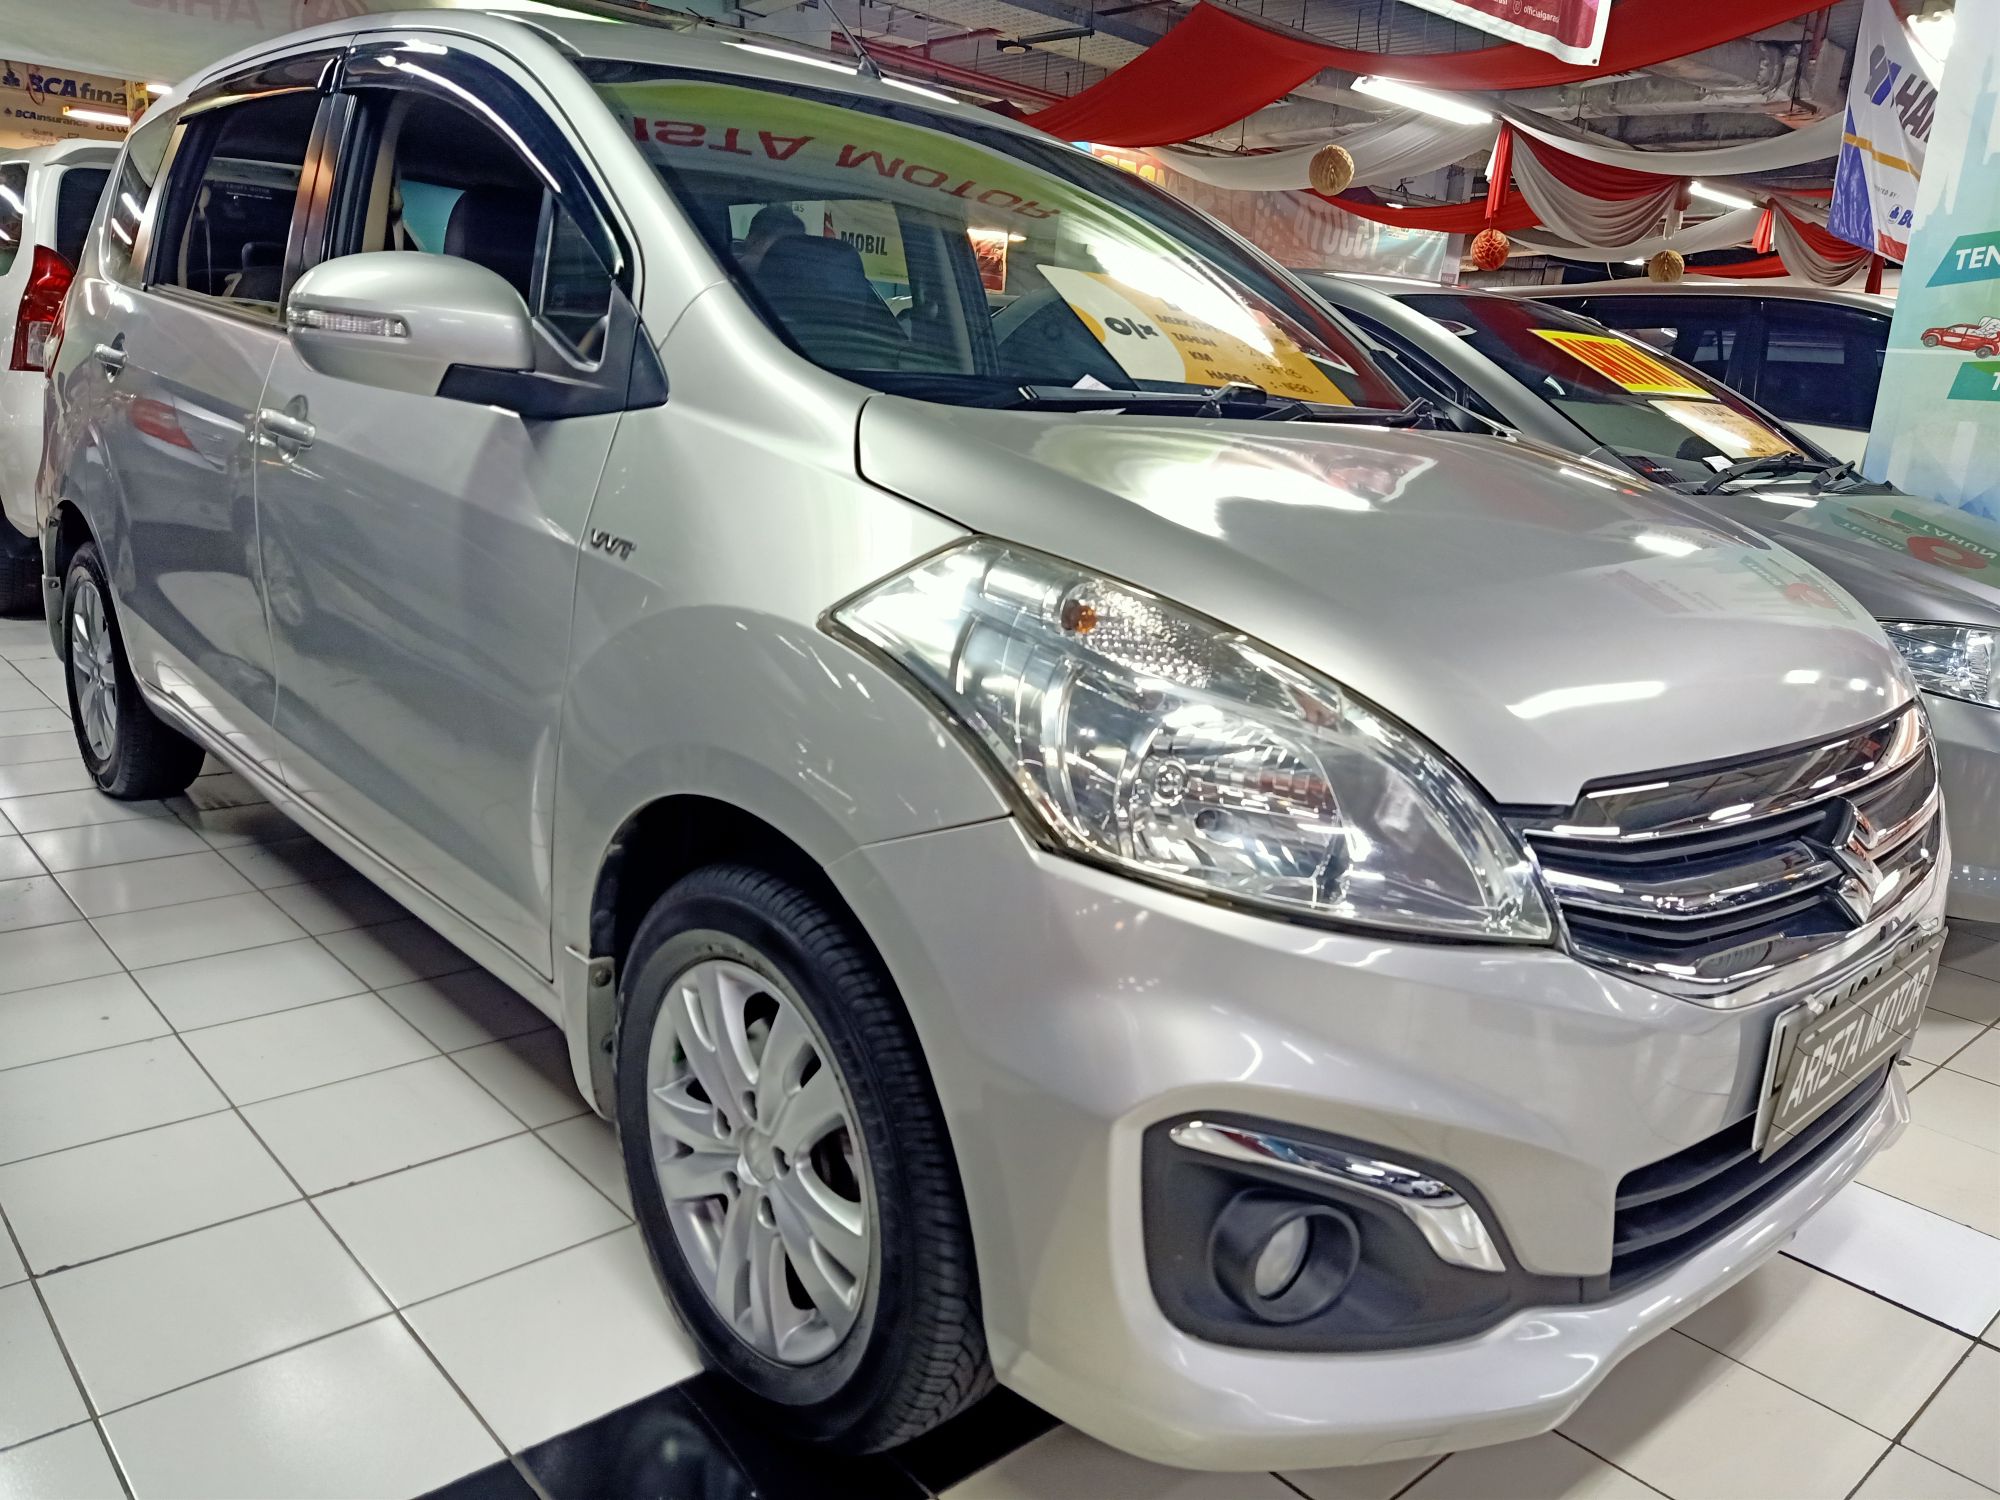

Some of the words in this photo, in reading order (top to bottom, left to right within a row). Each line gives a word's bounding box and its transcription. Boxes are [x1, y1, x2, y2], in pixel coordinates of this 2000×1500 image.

[840, 231, 888, 256] MOBIL
[1188, 350, 1214, 363] KM
[1781, 1012, 1866, 1118] ARISTA
[1859, 964, 1931, 1057] MOTOR
